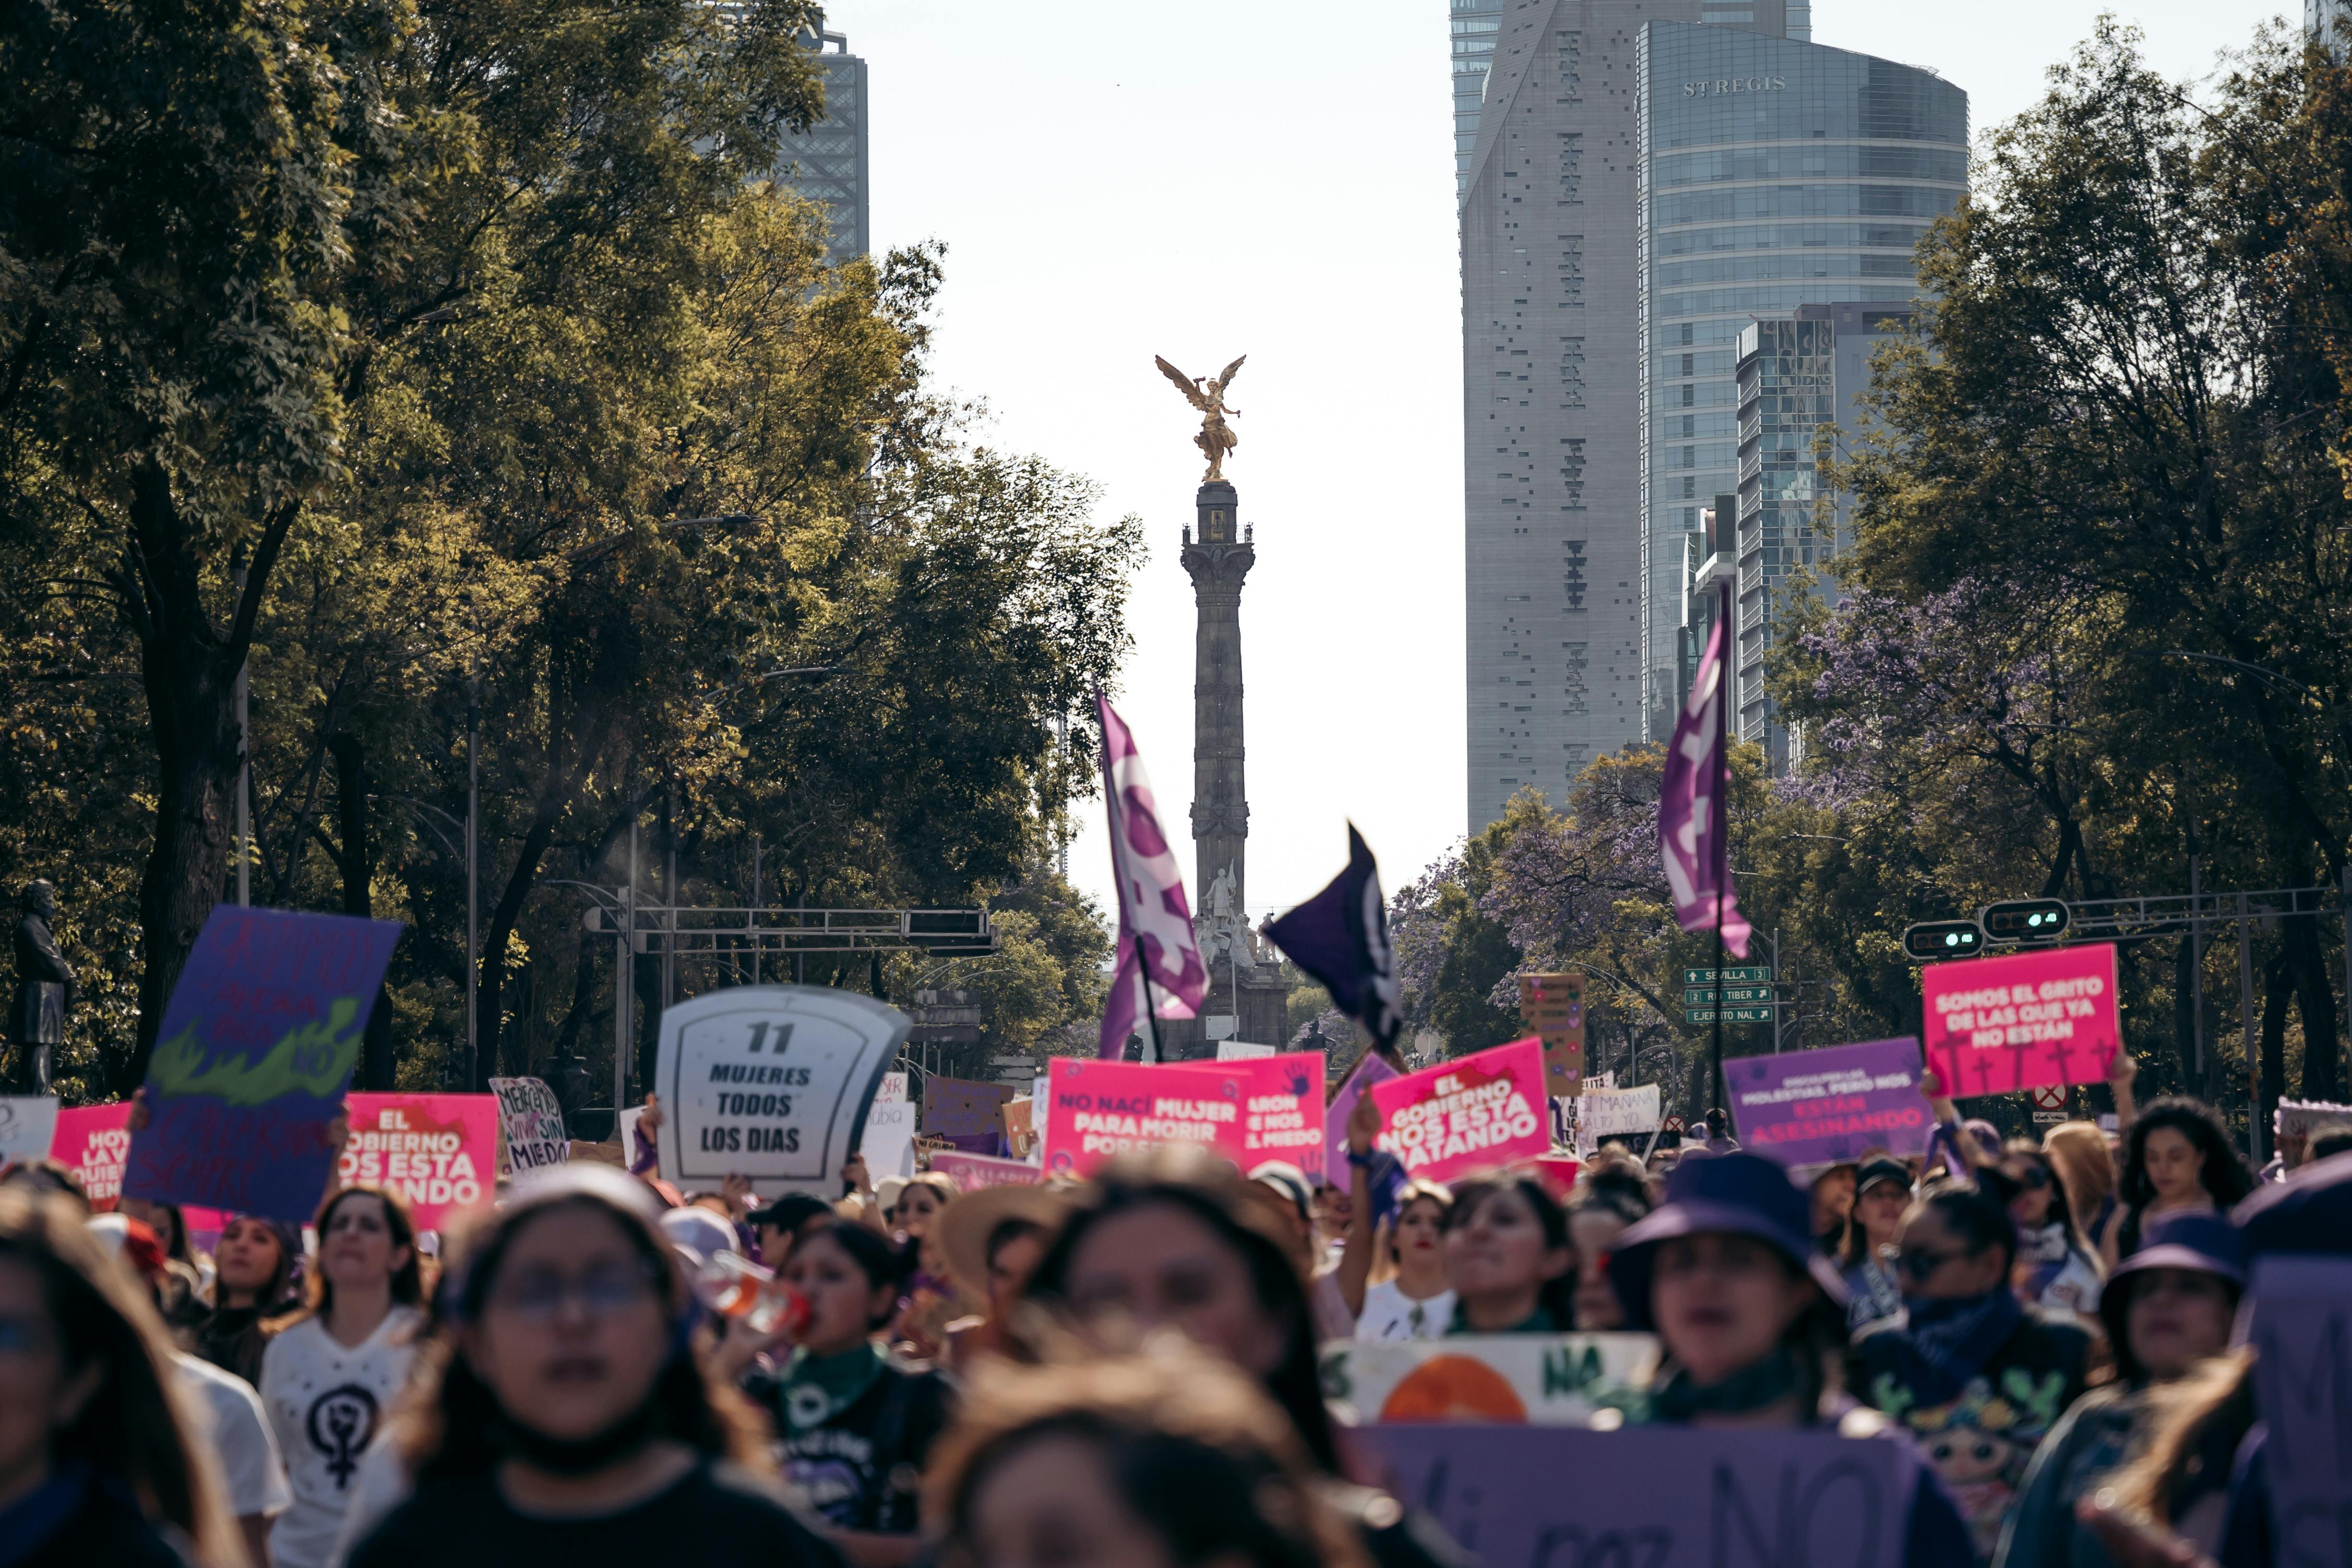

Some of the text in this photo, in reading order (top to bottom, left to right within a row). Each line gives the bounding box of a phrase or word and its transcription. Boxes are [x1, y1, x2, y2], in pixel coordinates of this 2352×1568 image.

[1715, 76, 1786, 94] REGIS
[1727, 991, 1752, 1000] TIBER
[1935, 976, 2104, 1013] SOMOS EL GRITO
[1694, 1011, 1754, 1021] EJERITO NAL
[1946, 998, 2095, 1032] DE LAS QUE YA
[746, 1021, 795, 1055] 11
[1972, 1028, 2004, 1049] NO
[709, 1063, 810, 1086] MUJERES
[1435, 1074, 1464, 1095] EL
[1829, 1078, 1874, 1095] PERO
[1875, 1071, 1912, 1090] NOS
[496, 1085, 559, 1118] MERECEMOS
[718, 1092, 792, 1117] TODOS
[1058, 1094, 1092, 1110] NO
[1155, 1097, 1236, 1122] MUJER
[1391, 1079, 1511, 1128] GOBIERNO
[379, 1108, 410, 1130] EL
[507, 1118, 564, 1141] VIVIR SIN
[1074, 1112, 1216, 1142] PARA MORIR
[1264, 1112, 1304, 1130] NOS
[1378, 1117, 1445, 1153] NOS
[1449, 1092, 1530, 1132] ESTA
[1623, 1112, 1639, 1127] YO
[1751, 1107, 1923, 1145] ASESINANDO
[347, 1131, 461, 1153] OBIERNO
[701, 1127, 799, 1154] LOS DIAS
[1083, 1135, 1130, 1156] POR
[1262, 1128, 1321, 1147] MIEDO
[339, 1151, 476, 1179] OS ESTA
[511, 1142, 568, 1169] MIEDO
